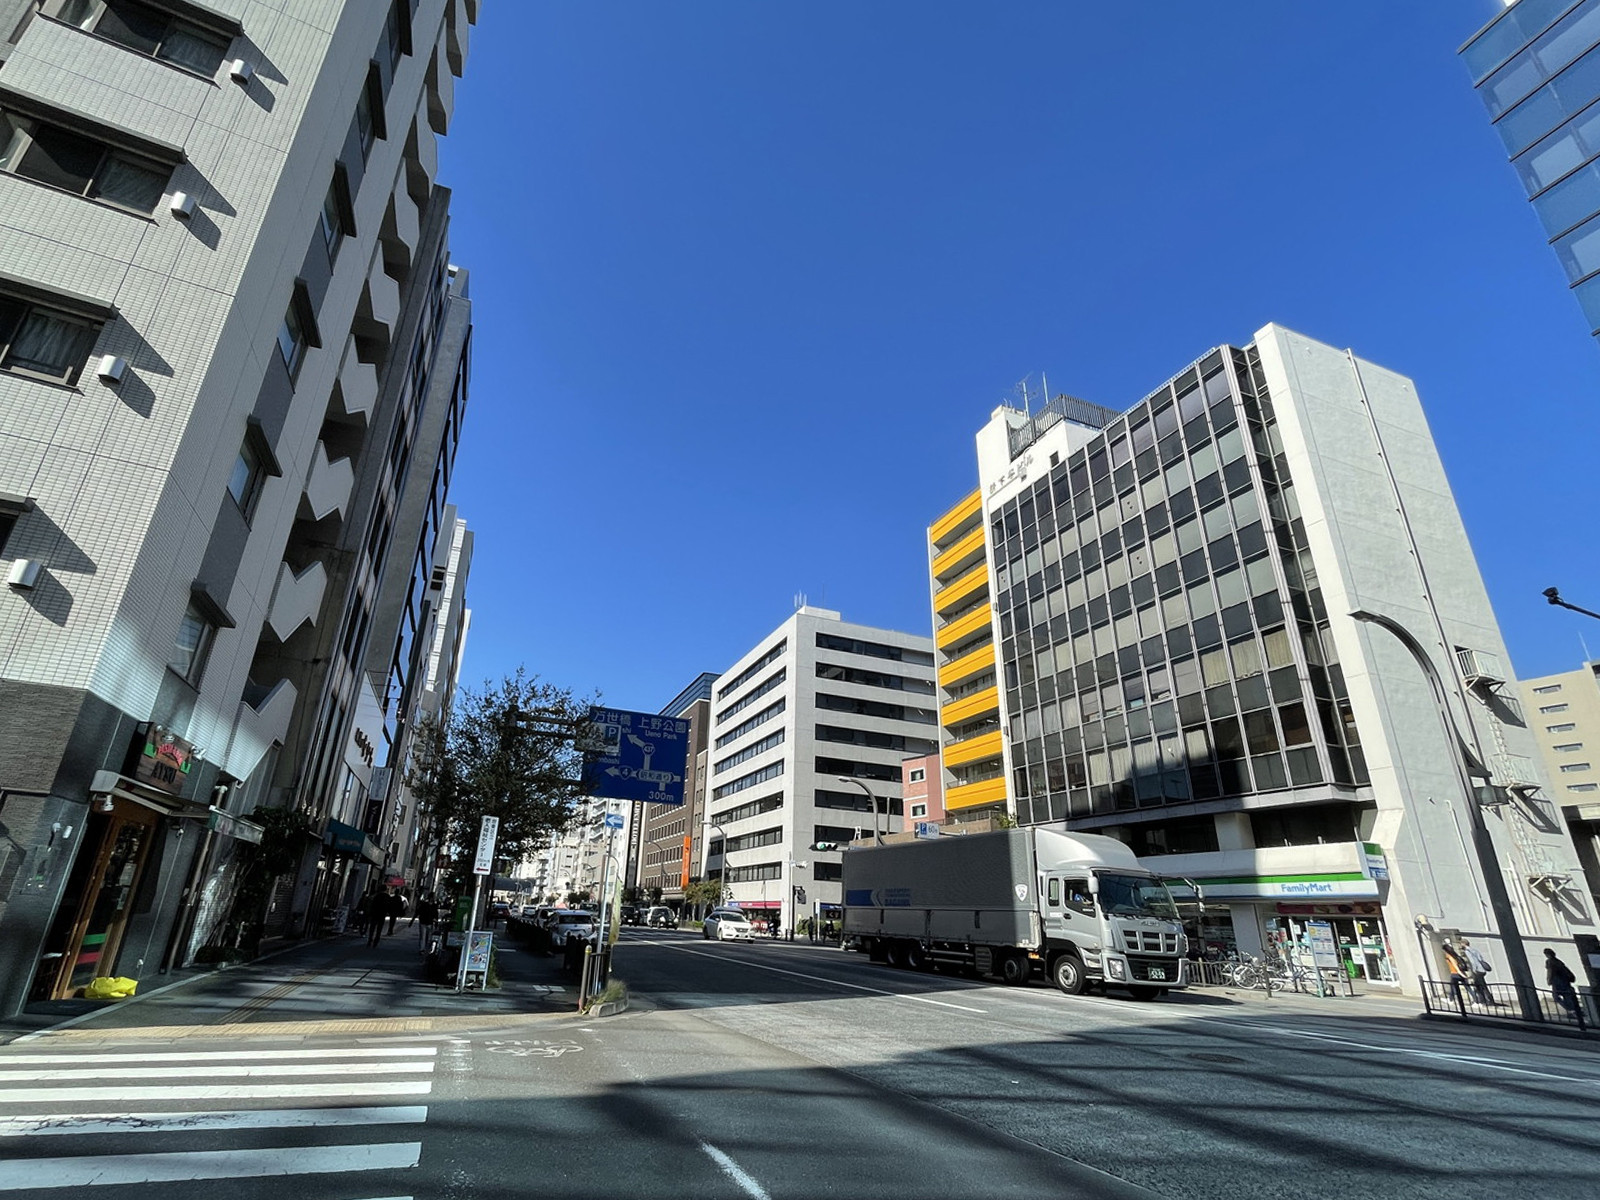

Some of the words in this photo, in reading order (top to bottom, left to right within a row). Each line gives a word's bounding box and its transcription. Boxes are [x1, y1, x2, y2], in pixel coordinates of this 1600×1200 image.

[639, 716, 686, 733] 上野公園
[645, 730, 661, 738] Ueno
[663, 732, 678, 740] Park
[648, 791, 674, 801] 300m
[1281, 883, 1332, 895] FamilyMart
